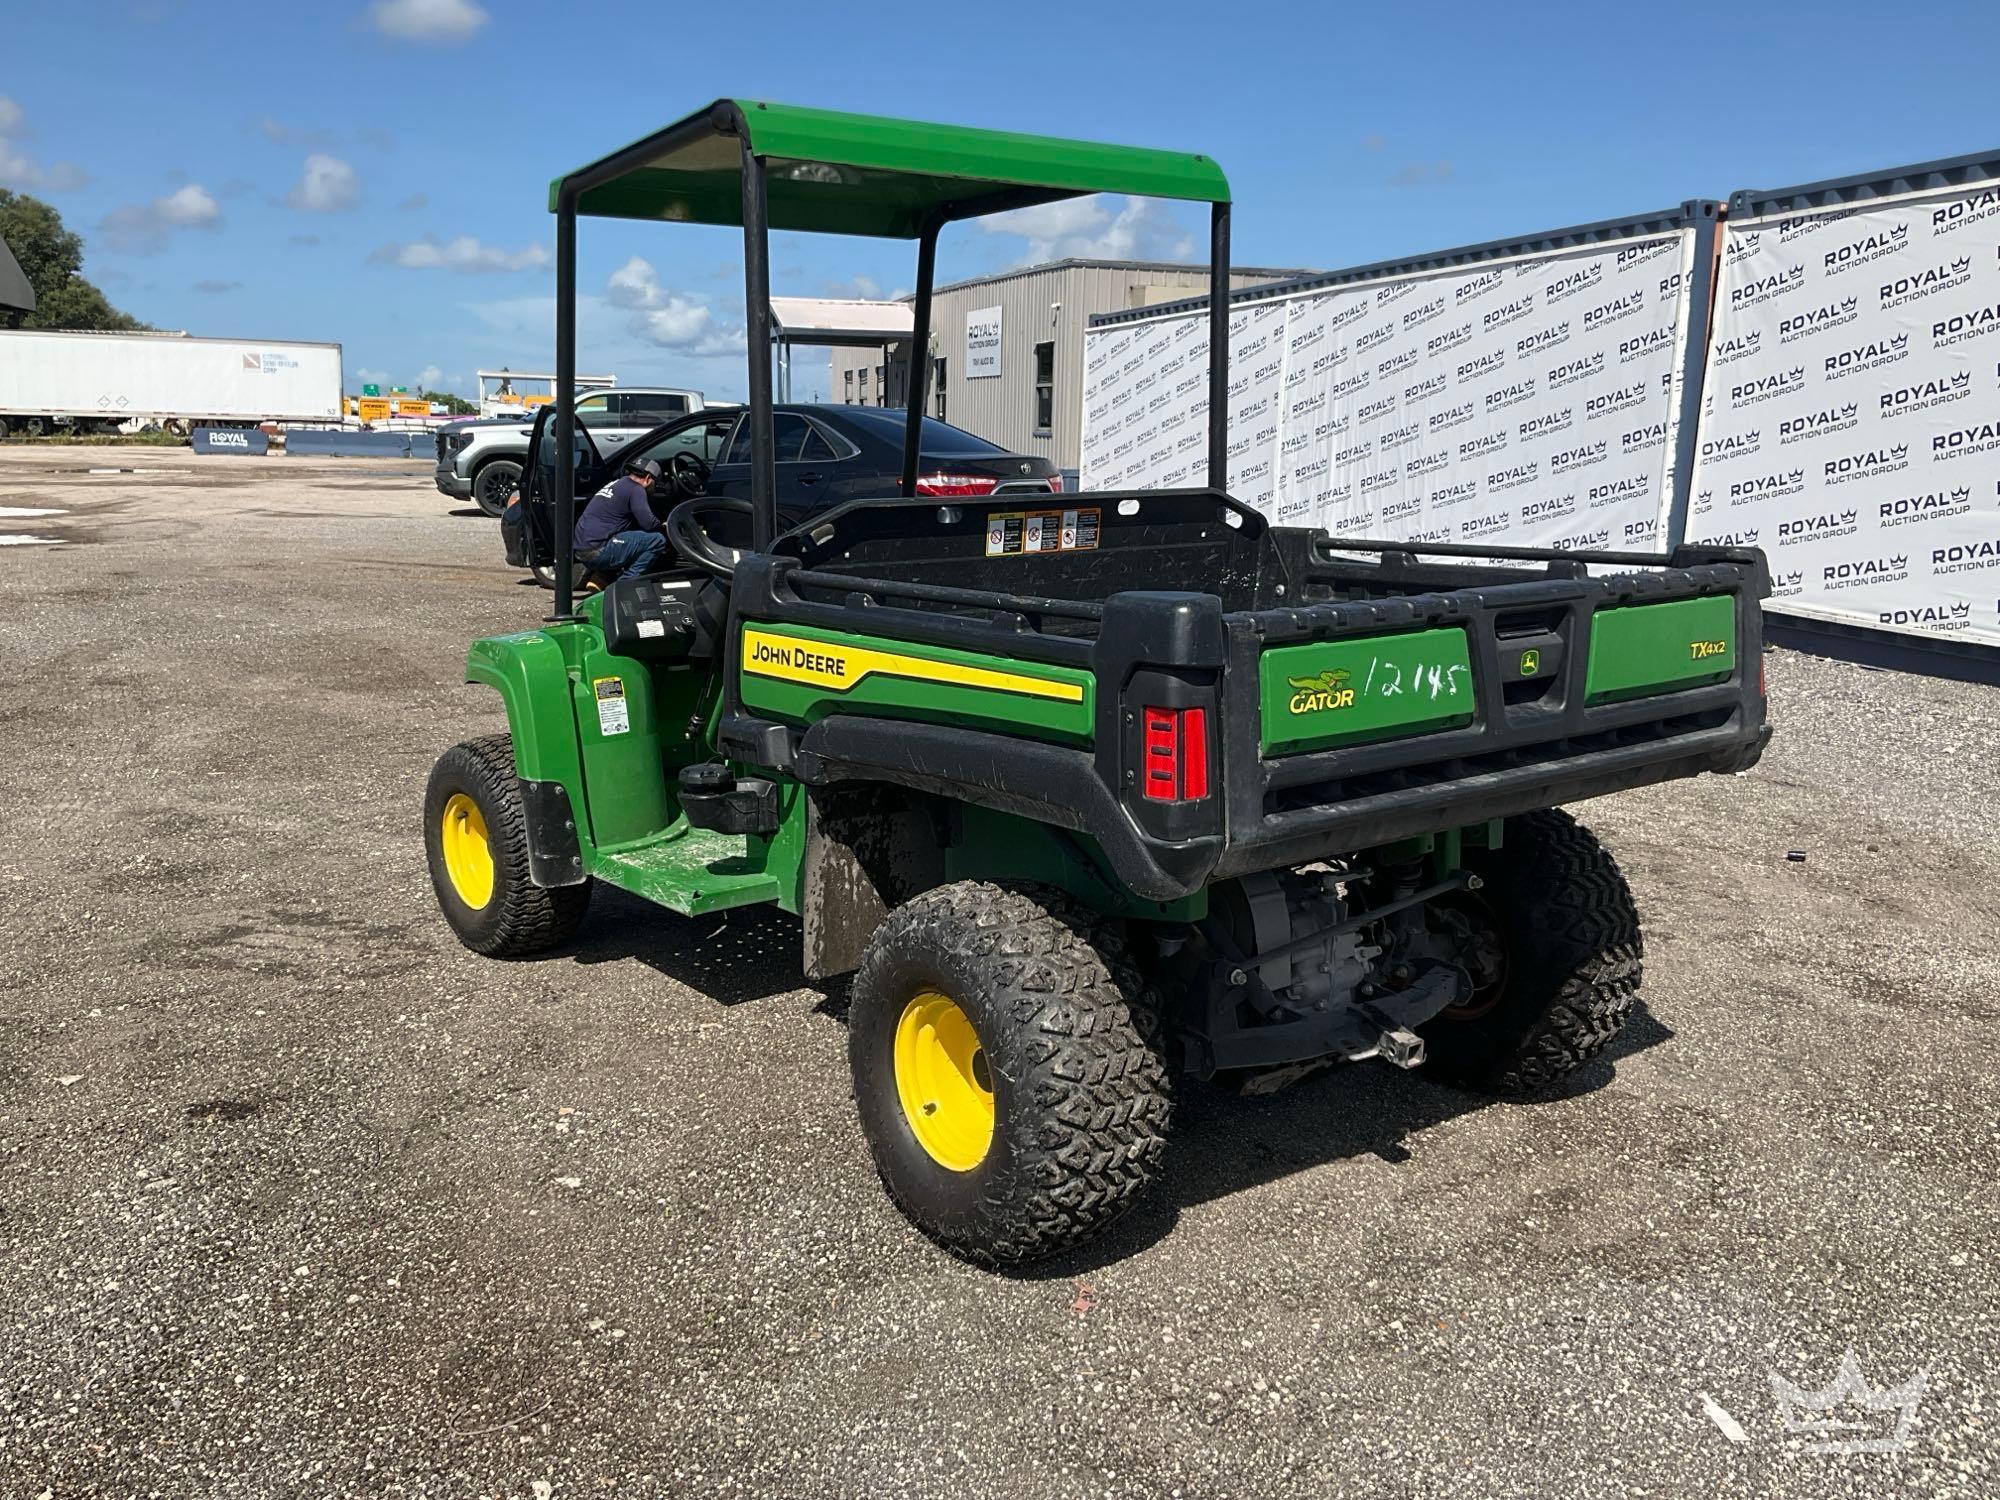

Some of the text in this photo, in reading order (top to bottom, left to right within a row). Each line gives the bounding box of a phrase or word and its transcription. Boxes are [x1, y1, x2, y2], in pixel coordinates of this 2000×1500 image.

[1933, 211, 1985, 237] AUCTION
[1730, 247, 1761, 265] GROUP
[1824, 233, 1889, 268] ROYAL
[1824, 240, 1909, 278] AUCTION GROUP
[1456, 274, 1492, 299] ROYAL
[1546, 269, 1590, 298] ROYAL
[1547, 276, 1602, 306] AUCTION GROUP
[1731, 272, 1788, 303] ROYAL
[1880, 265, 1950, 301] ROYAL
[1880, 274, 1971, 311] AUCTION GROUP
[1732, 280, 1805, 313] AUCTION GROUP
[1332, 305, 1360, 326] ROYAL
[1403, 302, 1436, 325] ROYAL
[1483, 301, 1522, 326] ROYAL
[1584, 297, 1630, 325] ROYAL
[1584, 304, 1644, 333] AUCTION GROUP
[1780, 304, 1840, 335] ROYAL
[968, 323, 992, 339] ROYAL
[1292, 328, 1317, 349] ROYAL
[1356, 327, 1386, 349] ROYAL
[1427, 328, 1462, 351] ROYAL
[1780, 312, 1858, 345] AUCTION GROUP
[1933, 327, 1985, 349] AUCTION
[1517, 327, 1558, 353] ROYAL
[1517, 334, 1570, 361] AUCTION GROUP
[1619, 328, 1668, 356] ROYAL
[1715, 337, 1745, 357] YAL
[1313, 350, 1340, 371] ROYAL
[1378, 352, 1409, 374] ROYAL
[1457, 354, 1494, 377] ROYAL
[1620, 346, 1653, 364] AUCTION
[1731, 346, 1761, 364] GROUP
[1825, 341, 1890, 372] ROYAL
[1825, 350, 1909, 382] AUCTION GROUP
[1548, 357, 1592, 382] ROYAL
[1549, 365, 1605, 391] AUCTION GROUP
[1333, 374, 1362, 395] ROYAL
[1405, 378, 1437, 399] ROYAL
[1485, 383, 1524, 406] ROYAL
[1732, 373, 1788, 400] ROYAL
[1880, 378, 1950, 409] ROYAL
[1293, 395, 1319, 414] ROYAL
[1486, 391, 1536, 414] AUCTION GROUP
[1586, 387, 1633, 413] ROYAL
[1731, 382, 1805, 410] AUCTION GROUP
[1880, 389, 1971, 420] AUCTION GROUP
[1358, 399, 1387, 419] ROYAL
[1429, 406, 1464, 427] ROYAL
[1586, 396, 1646, 421] AUCTION GROUP
[1315, 418, 1342, 437] ROYAL
[1519, 412, 1561, 435] ROYAL
[1520, 421, 1573, 443] AUCTION GROUP
[1779, 419, 1858, 446] AUCTION GROUP
[1780, 409, 1840, 436] ROYAL
[209, 432, 246, 442] ROYAL
[1380, 426, 1411, 445] ROYAL
[1459, 434, 1496, 455] ROYAL
[1702, 435, 1744, 456] OYAL
[1335, 444, 1364, 462] ROYAL
[1551, 445, 1594, 467] ROYAL
[1623, 439, 1656, 455] AUCTION
[1700, 445, 1761, 466] CTION GROUP
[1933, 444, 1984, 462] AUCTION
[1295, 461, 1320, 478] ROYAL
[1406, 454, 1439, 473] ROYAL
[1551, 454, 1607, 475] AUCTION GROUP
[1824, 449, 1890, 476] ROYAL
[1824, 461, 1909, 486] AUCTION GROUP
[1360, 471, 1389, 488] ROYAL
[1488, 466, 1527, 486] ROYAL
[1488, 474, 1539, 494] AUCTION GROUP
[1730, 473, 1788, 497] ROYAL
[1316, 486, 1343, 503] ROYAL
[1431, 484, 1466, 502] ROYAL
[1589, 478, 1635, 500] ROYAL
[1589, 489, 1649, 509] AUCTION GROUP
[1730, 485, 1804, 507] AUCTION GROUP
[1277, 501, 1303, 516] ROYAL
[1382, 500, 1413, 517] ROYAL
[1522, 498, 1563, 518] ROYAL
[1522, 507, 1576, 525] AUCTION GROUP
[1879, 492, 1950, 518] ROYAL
[1337, 514, 1365, 530] ROYAL
[1462, 514, 1499, 533] ROYAL
[1624, 519, 1656, 536] ROY
[1778, 513, 1840, 537] ROYAL
[1879, 505, 1971, 528] AUCTION GROUP
[1778, 526, 1858, 547] AUCTION GROUP
[1823, 558, 1889, 580] ROYAL
[1933, 561, 1984, 575] AUCTION
[1823, 572, 1908, 590] AUCTION GROUP
[752, 641, 845, 676] JOHN DEERE
[1363, 656, 1468, 701] 12145
[1289, 688, 1354, 714] GATOR
